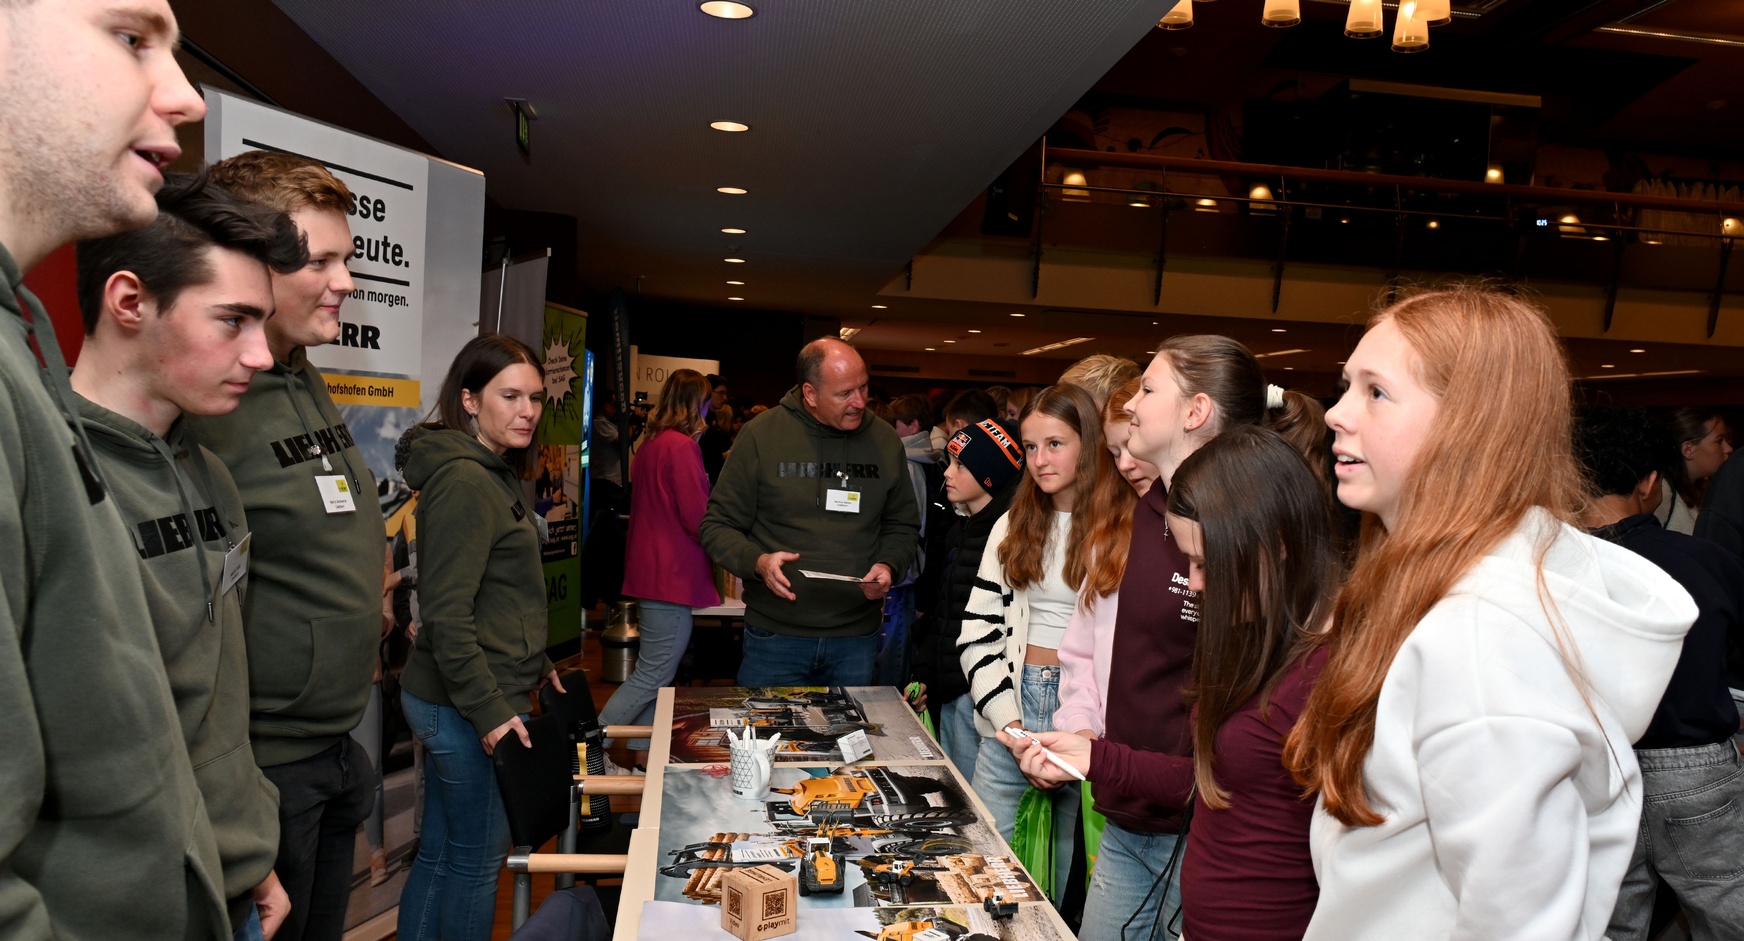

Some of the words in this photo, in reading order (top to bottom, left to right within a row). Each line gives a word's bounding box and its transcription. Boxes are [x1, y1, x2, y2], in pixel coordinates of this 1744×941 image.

[352, 235, 410, 268] eute.
[367, 290, 409, 308] morgen.
[368, 385, 395, 397] GmbH
[544, 573, 567, 603] AG
[1183, 600, 1194, 608] The
[763, 917, 790, 931] playmit
